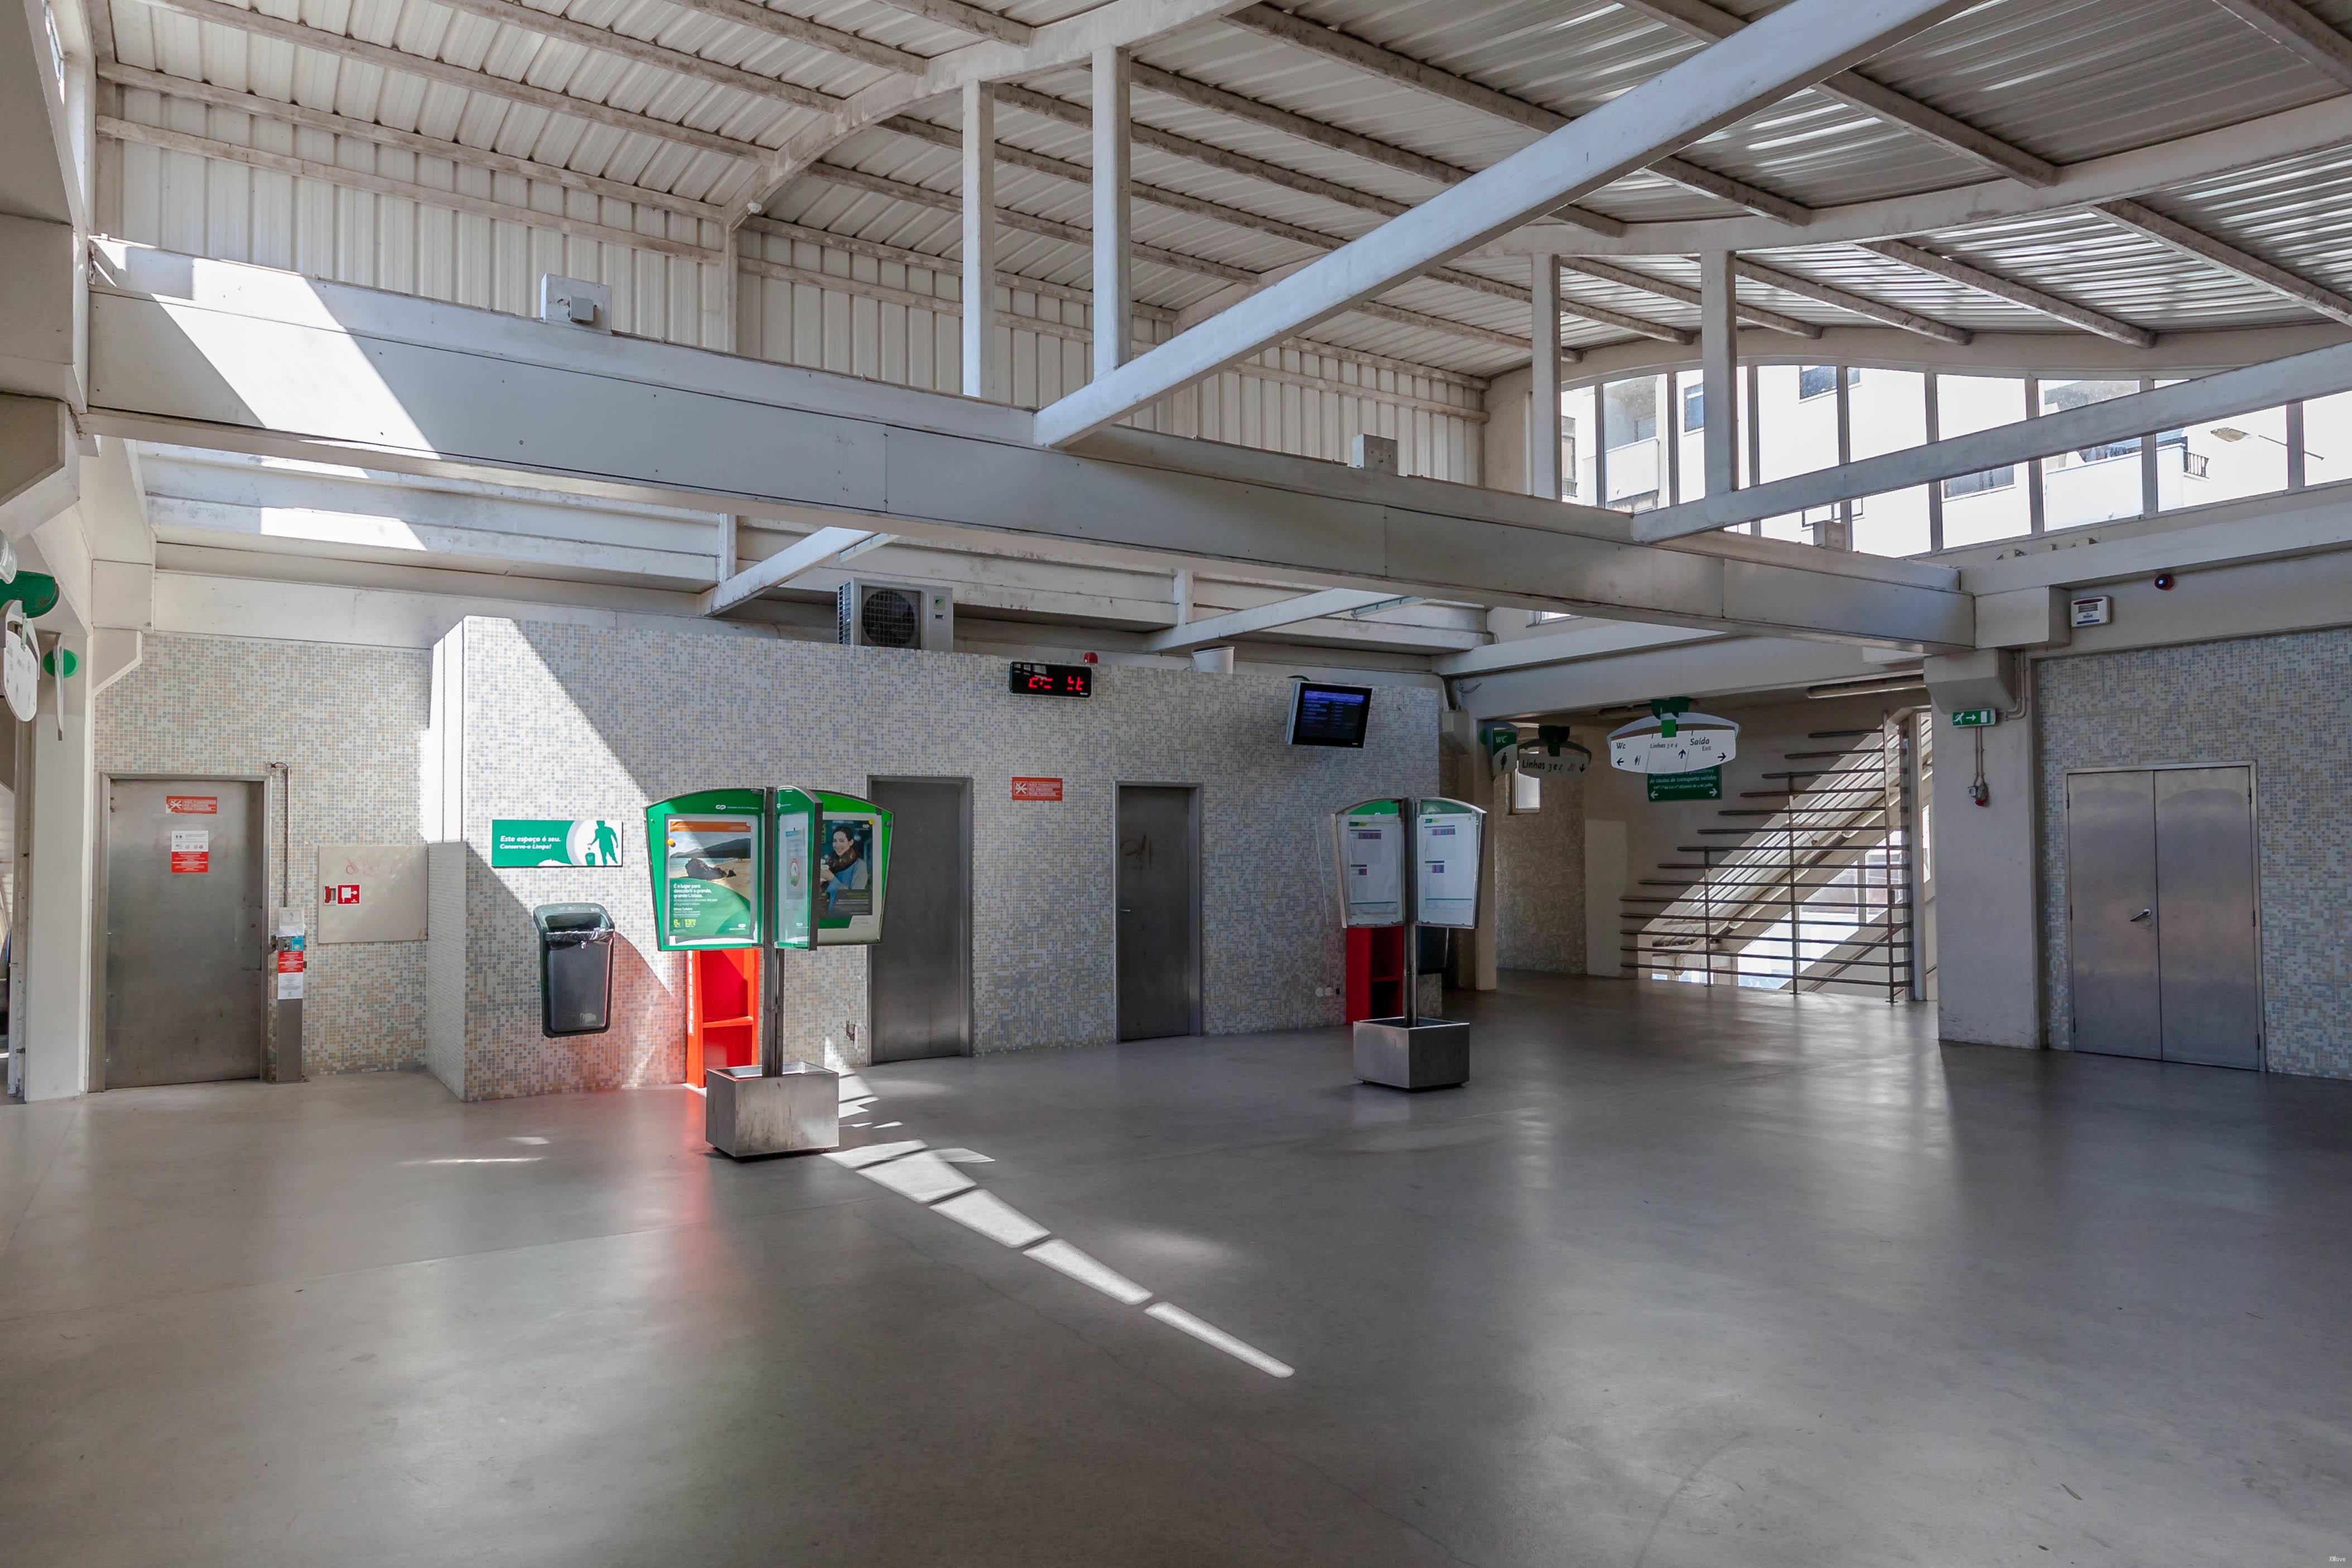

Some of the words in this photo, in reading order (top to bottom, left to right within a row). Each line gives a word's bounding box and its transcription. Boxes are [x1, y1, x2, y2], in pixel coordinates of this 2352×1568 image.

[1690, 737, 1710, 746] Saída
[1522, 759, 1545, 770] Linhas
[1548, 763, 1552, 772] 3
